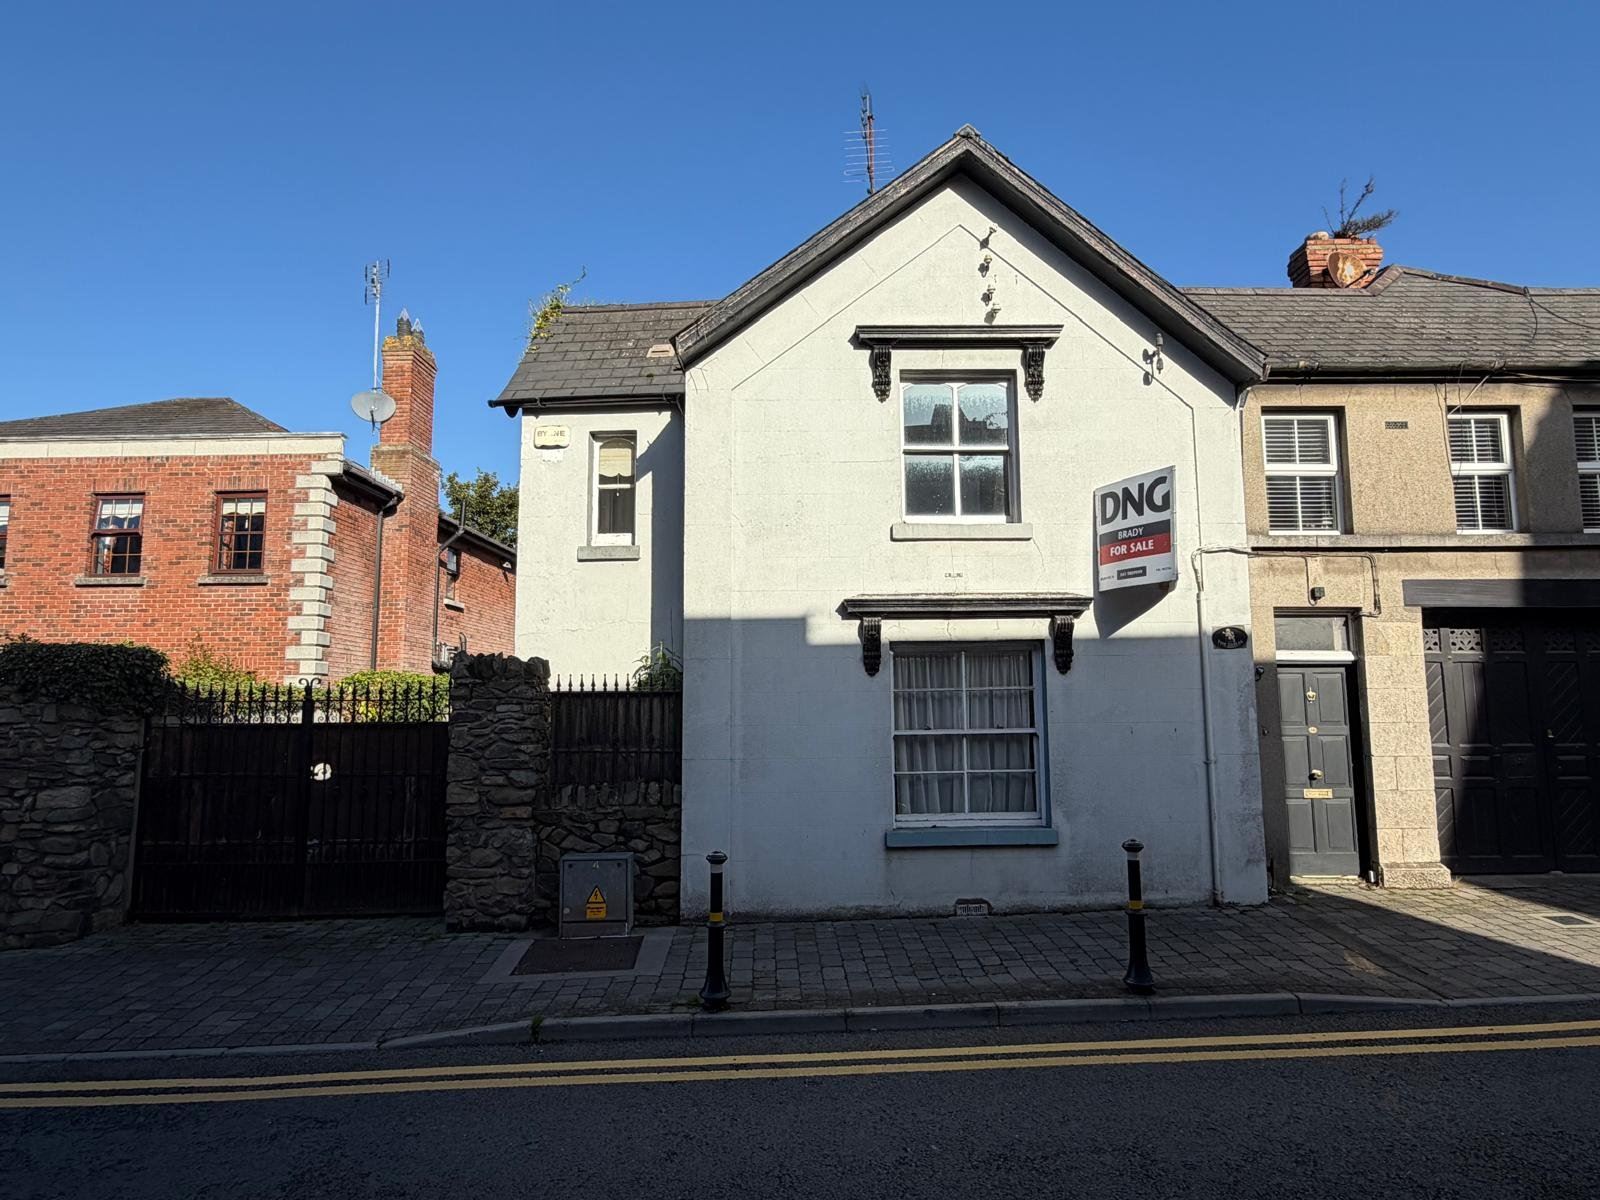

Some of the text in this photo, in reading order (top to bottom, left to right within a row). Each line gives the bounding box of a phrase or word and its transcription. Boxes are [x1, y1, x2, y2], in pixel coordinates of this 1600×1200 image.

[1100, 476, 1170, 526] DNG
[1118, 527, 1144, 540] BRADY
[1110, 540, 1154, 557] FOR SALE
